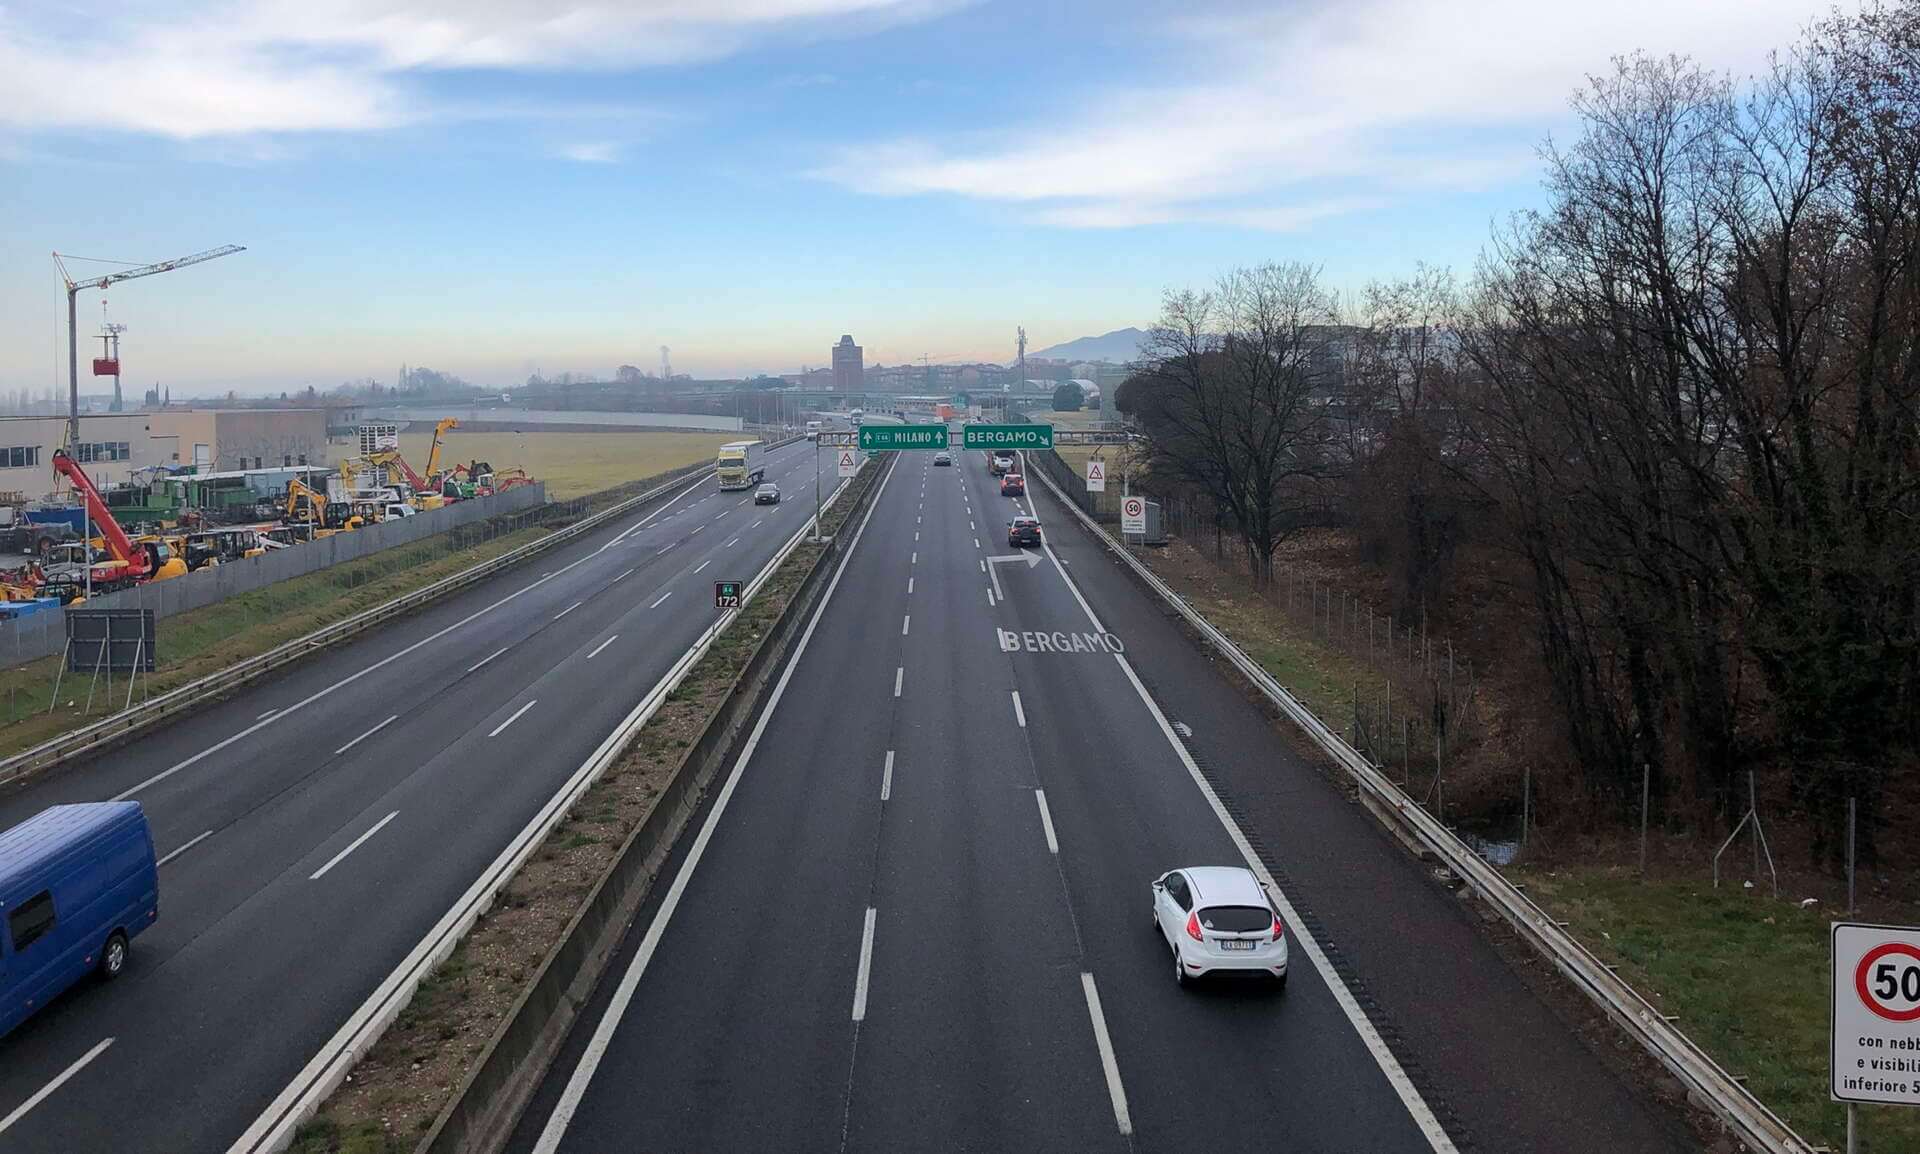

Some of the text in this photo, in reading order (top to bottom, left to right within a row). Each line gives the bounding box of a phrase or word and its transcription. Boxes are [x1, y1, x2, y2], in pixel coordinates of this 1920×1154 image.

[894, 432, 932, 443] MILANO
[967, 431, 1037, 443] BERGAMO
[1128, 504, 1139, 512] 50
[718, 596, 738, 607] 172
[1003, 631, 1124, 652] BERGAMO
[1875, 964, 1920, 1002] 50
[1858, 1036, 1883, 1048] con
[1857, 1058, 1865, 1069] e
[1844, 1075, 1907, 1093] inferiore
